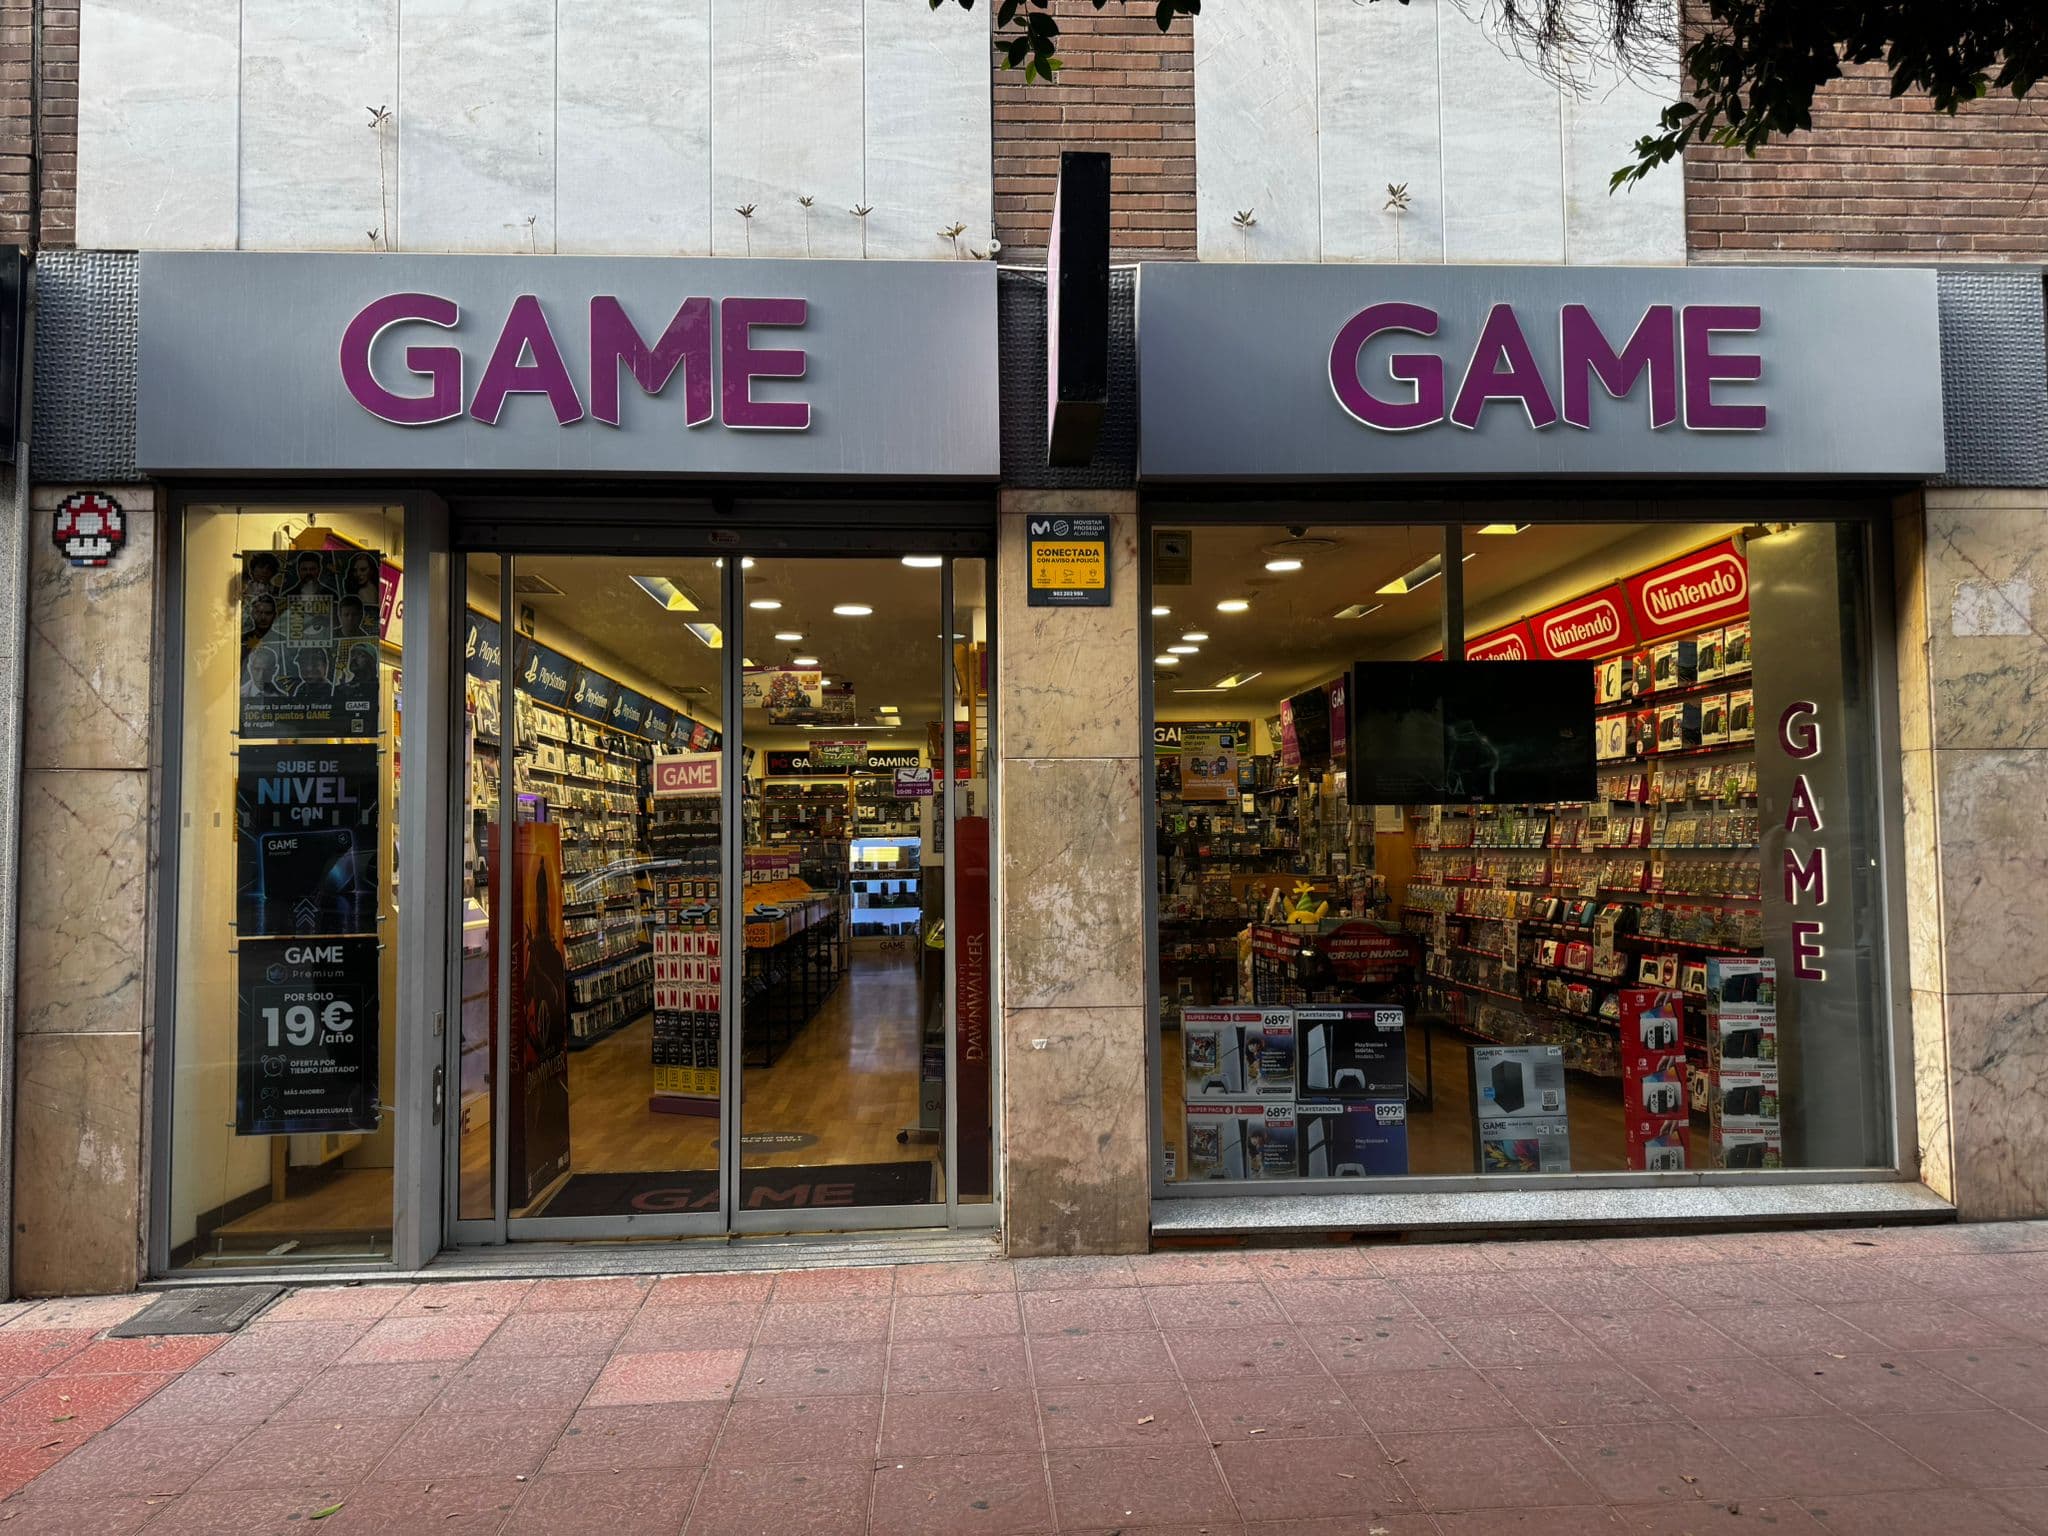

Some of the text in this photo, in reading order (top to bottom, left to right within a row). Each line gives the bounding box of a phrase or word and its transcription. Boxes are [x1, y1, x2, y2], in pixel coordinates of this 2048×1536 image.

[339, 291, 811, 429] GAME
[1327, 301, 1767, 430] GAME
[1036, 548, 1099, 557] CONECTADA
[1650, 567, 1736, 614] Nintendo
[1549, 612, 1612, 649] Nintendo
[538, 666, 567, 692] PlayStation
[586, 687, 608, 709] PlayStation
[274, 711, 304, 721] puntos
[306, 710, 331, 720] GAME
[276, 760, 339, 773] SUBE DE
[868, 757, 920, 768] GAMING
[663, 764, 713, 786] GAME
[257, 777, 357, 805] NIVEL
[290, 807, 323, 820] CON
[268, 839, 298, 850] GAME
[284, 946, 343, 964] GAME
[1368, 949, 1409, 959] NUNCA
[292, 969, 344, 979] Premium
[284, 992, 334, 1002] POR SOLO
[966, 932, 985, 1061] DAWNWALKER
[290, 1066, 318, 1074] TIEMPO
[1482, 1122, 1507, 1130] GAME
